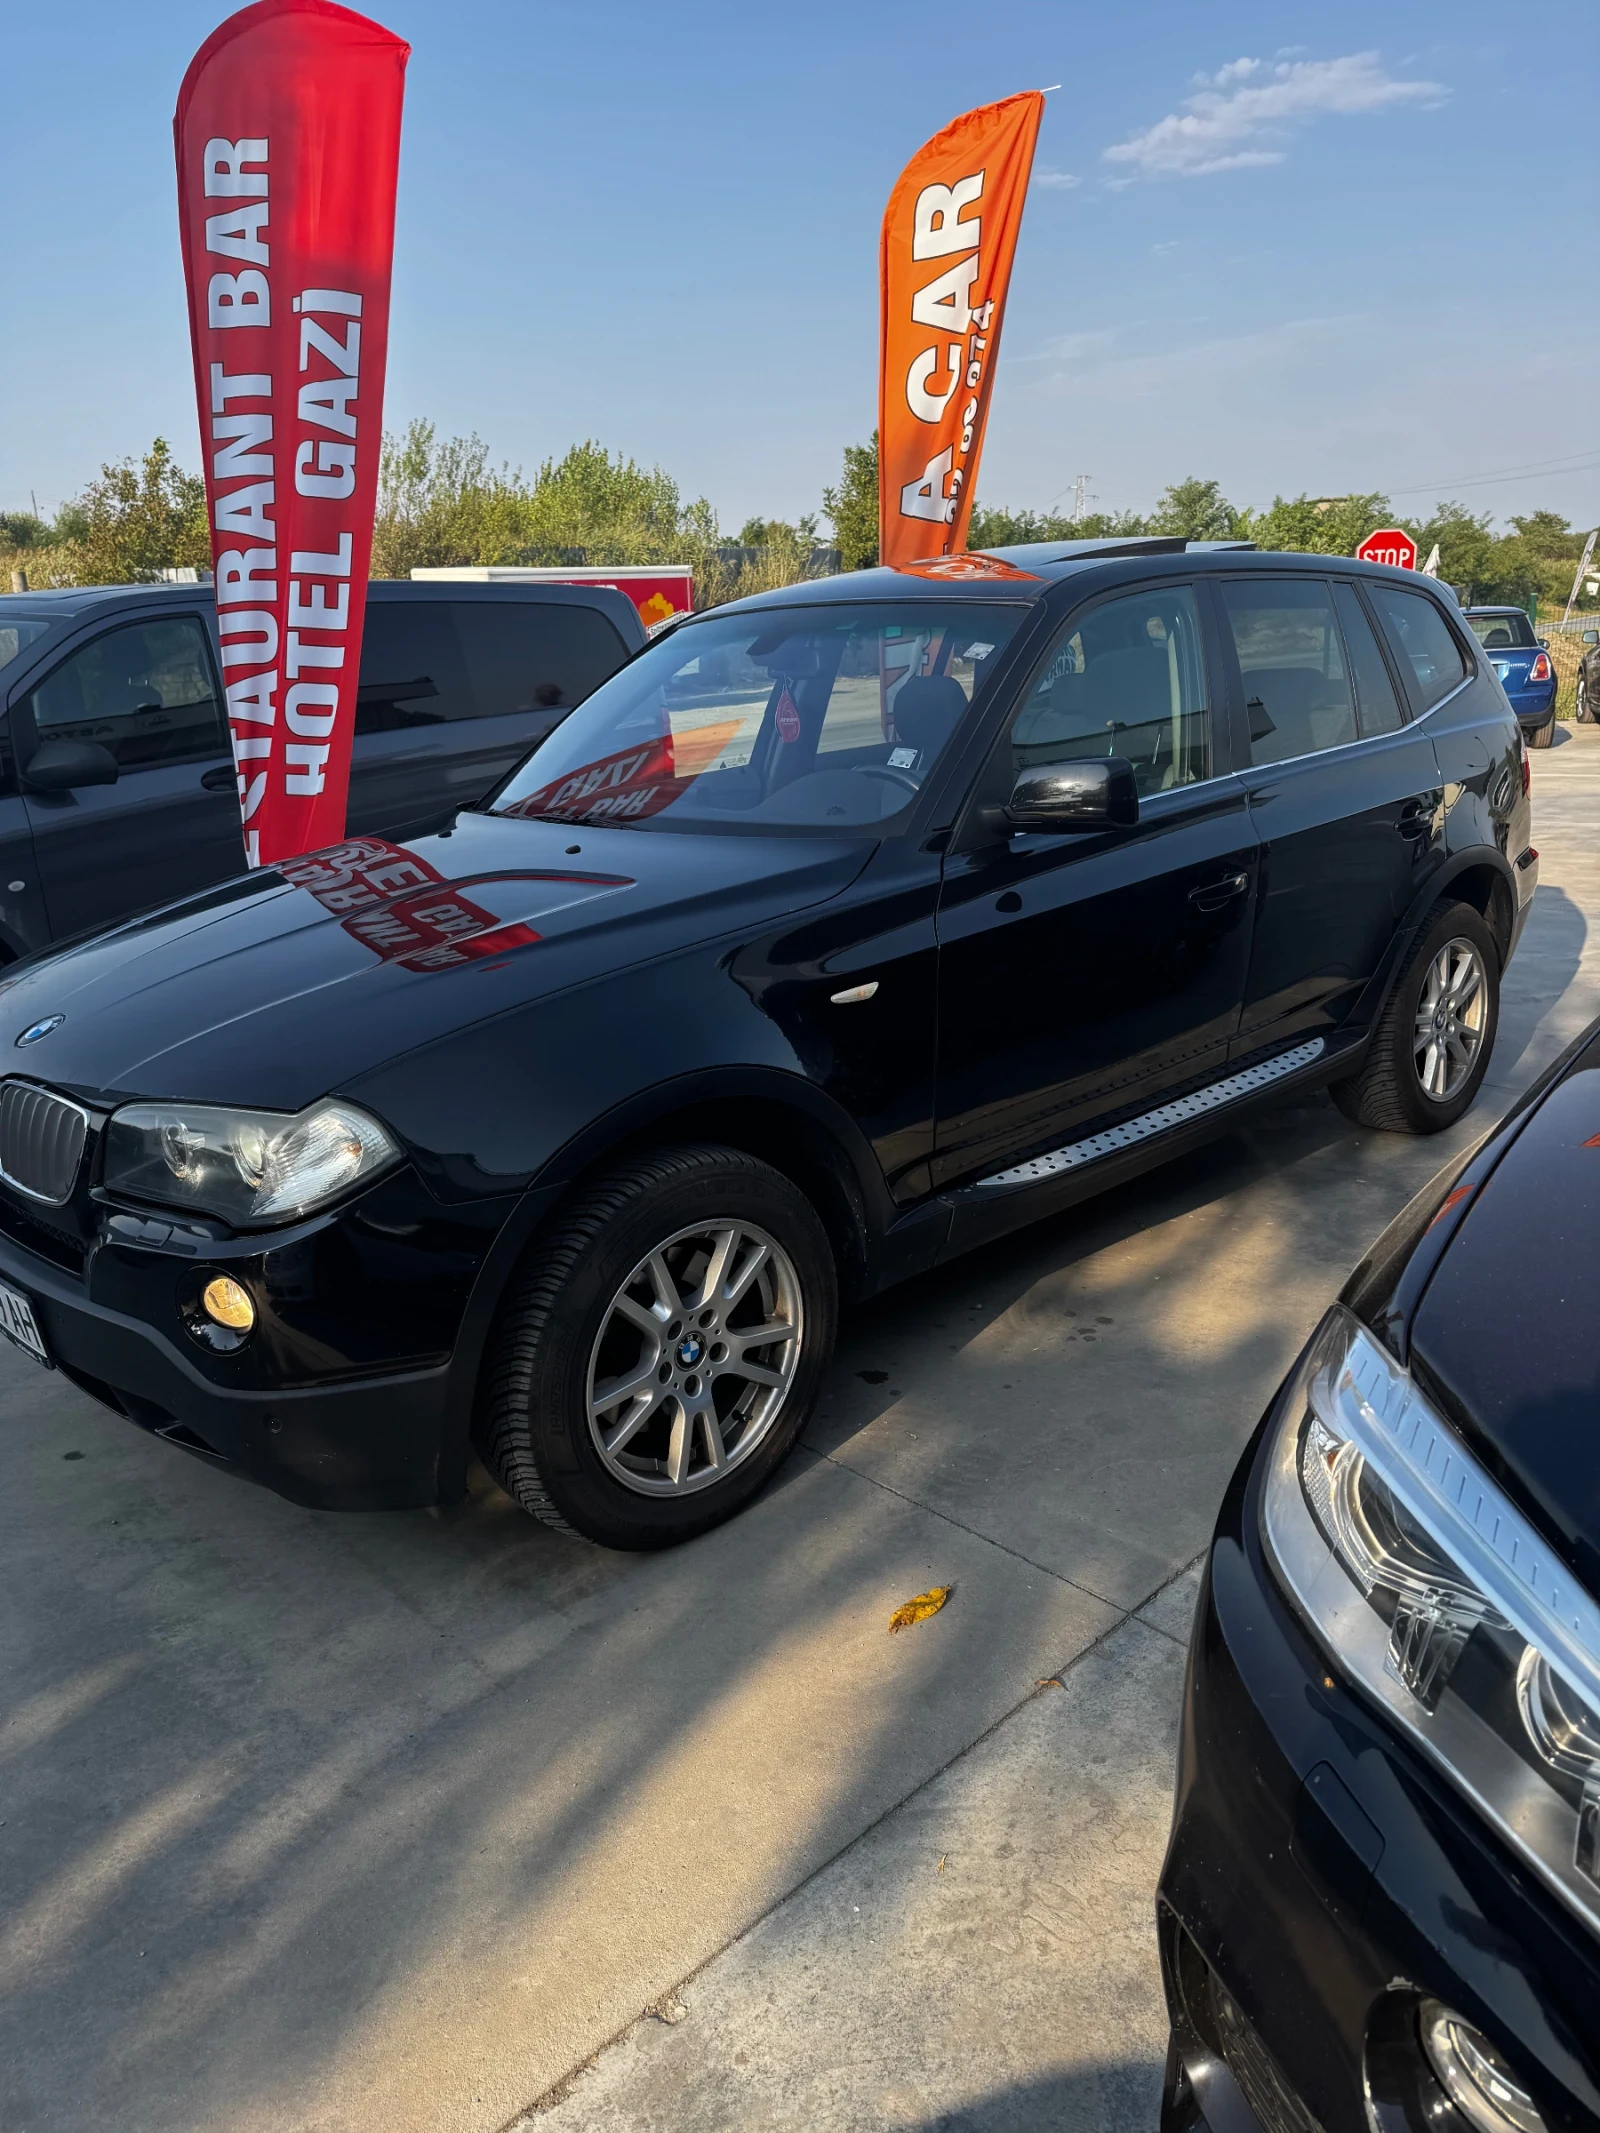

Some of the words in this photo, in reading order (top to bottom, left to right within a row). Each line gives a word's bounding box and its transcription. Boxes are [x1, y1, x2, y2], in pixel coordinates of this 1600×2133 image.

[203, 136, 271, 330] BAR
[905, 168, 986, 425] CAR
[285, 532, 353, 796] HOTEL
[1363, 548, 1410, 568] STOP
